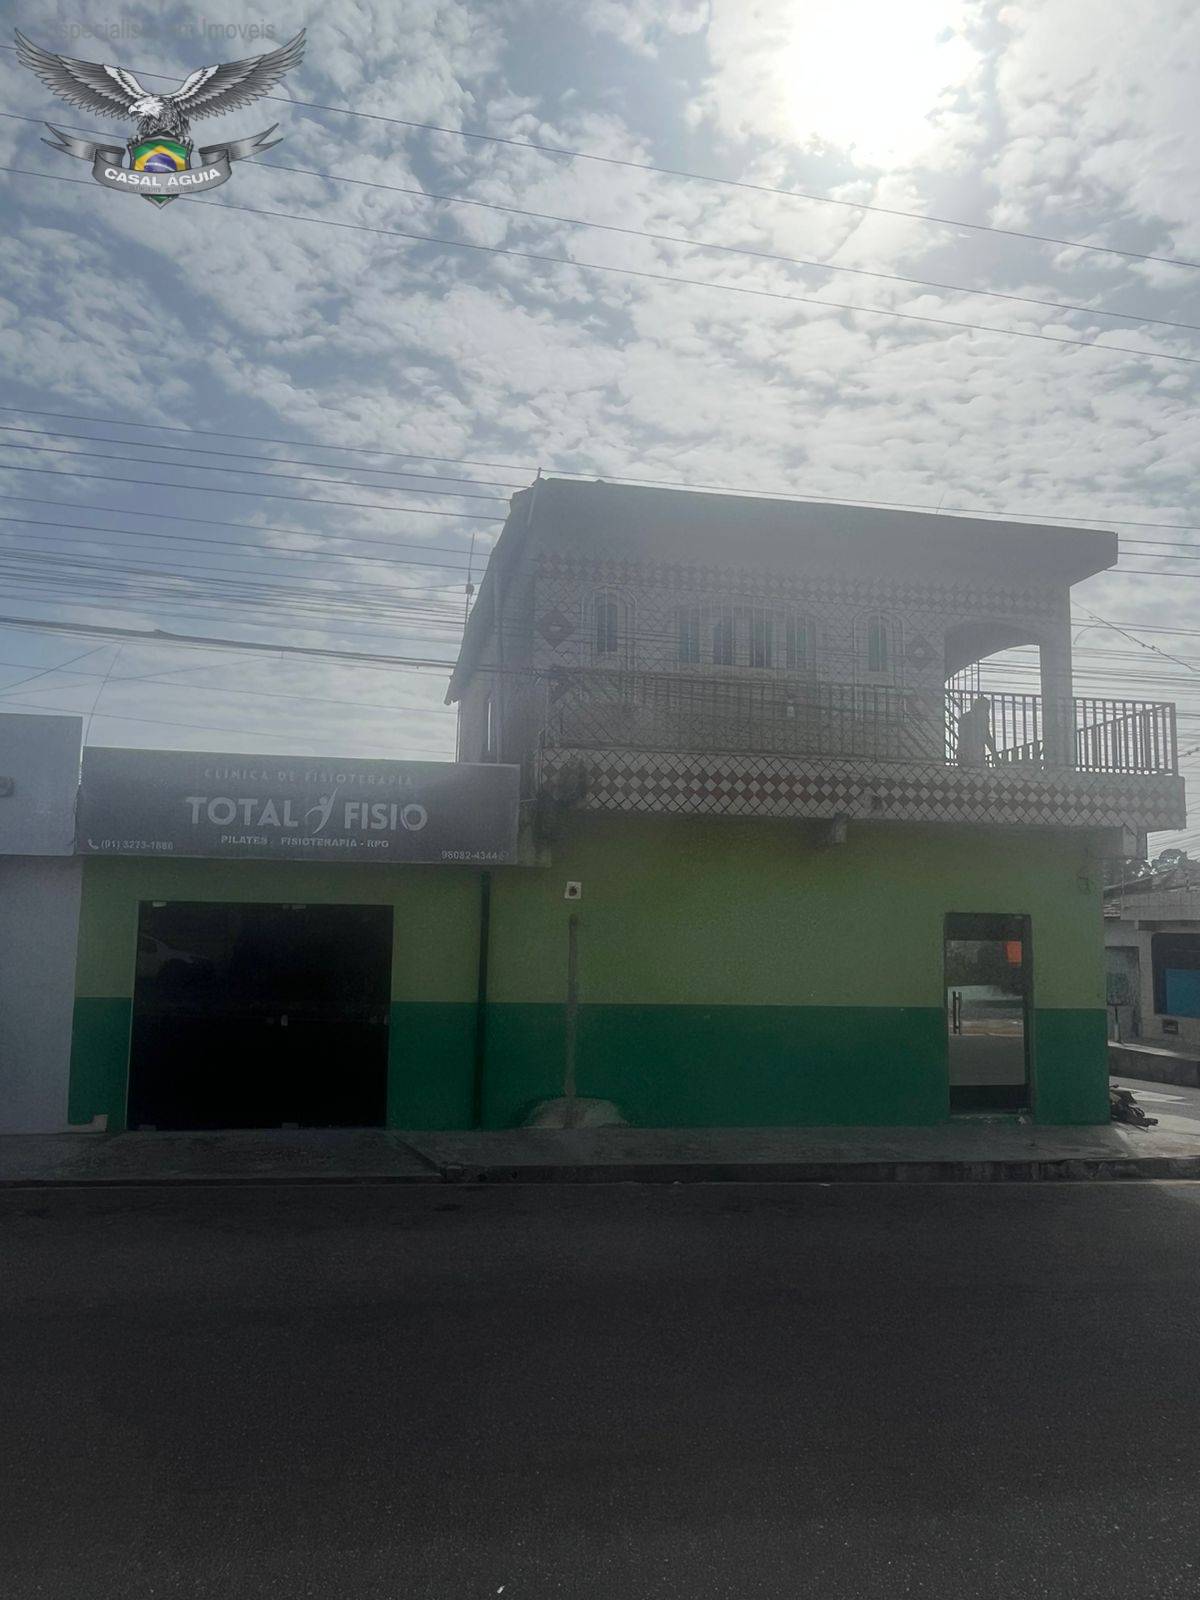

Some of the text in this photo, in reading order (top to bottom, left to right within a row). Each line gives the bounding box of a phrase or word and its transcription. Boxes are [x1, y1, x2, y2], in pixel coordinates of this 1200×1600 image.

[278, 771, 295, 782] DE
[304, 770, 413, 786] FISIOTERAPIA
[185, 796, 428, 831] TOTAL FISIO
[220, 835, 389, 848] PILATES FISIOTERAPIA RPG
